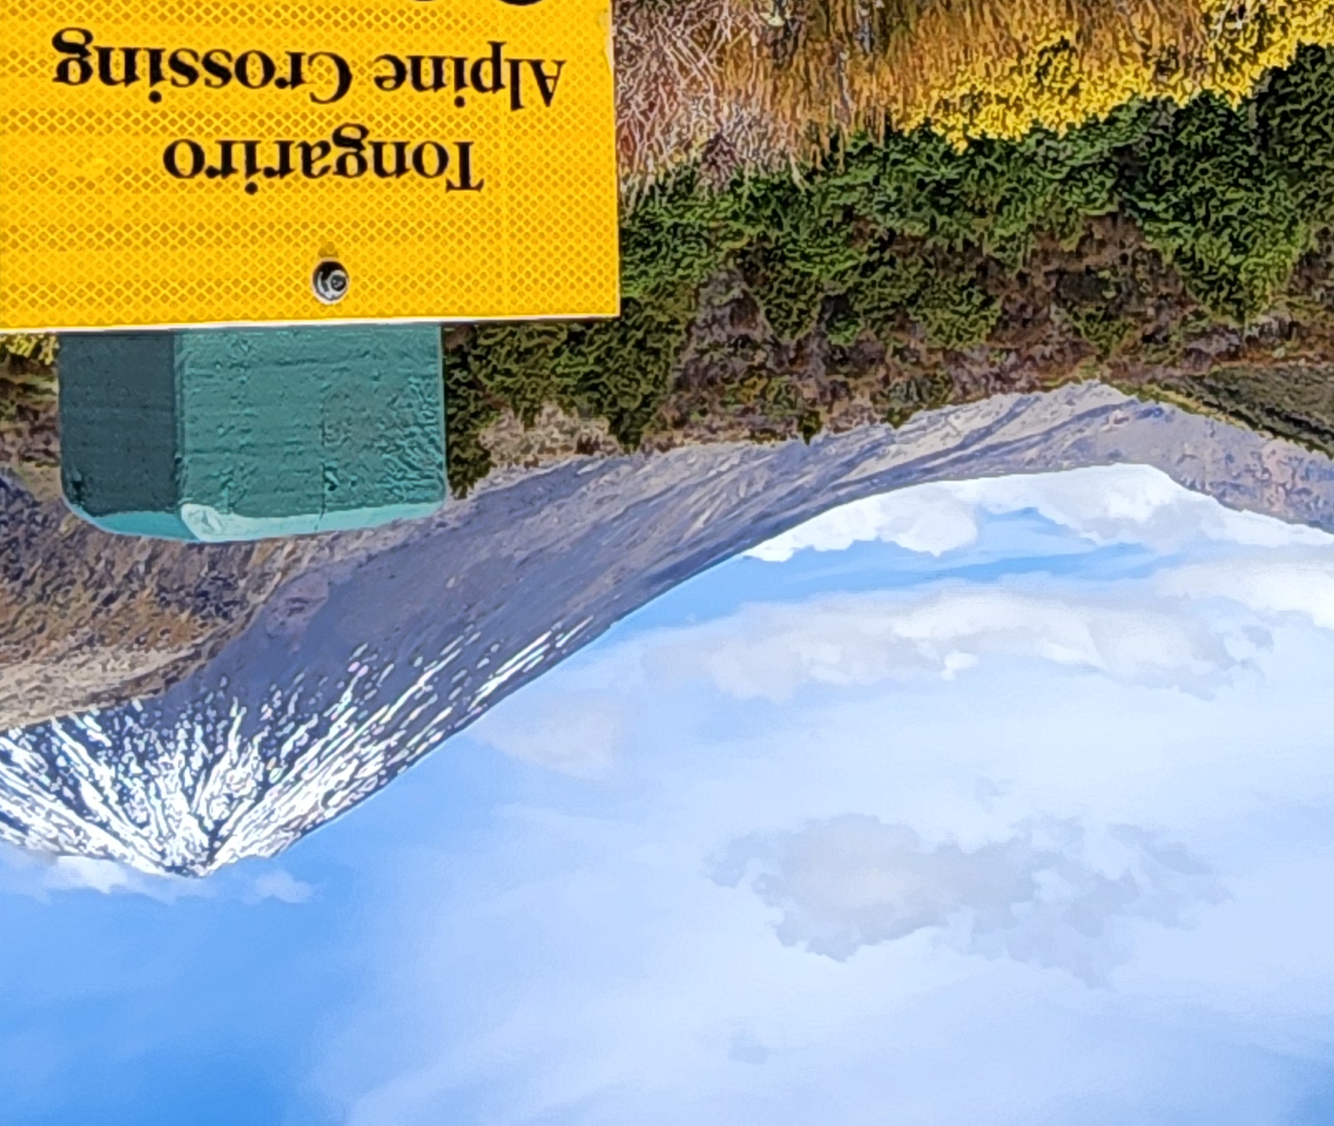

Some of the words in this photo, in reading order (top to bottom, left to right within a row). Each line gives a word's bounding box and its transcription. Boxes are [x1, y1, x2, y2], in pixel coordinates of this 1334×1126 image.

[51, 28, 353, 107] Crossing
[374, 41, 565, 111] Alpine
[163, 123, 485, 195] Tongariro
